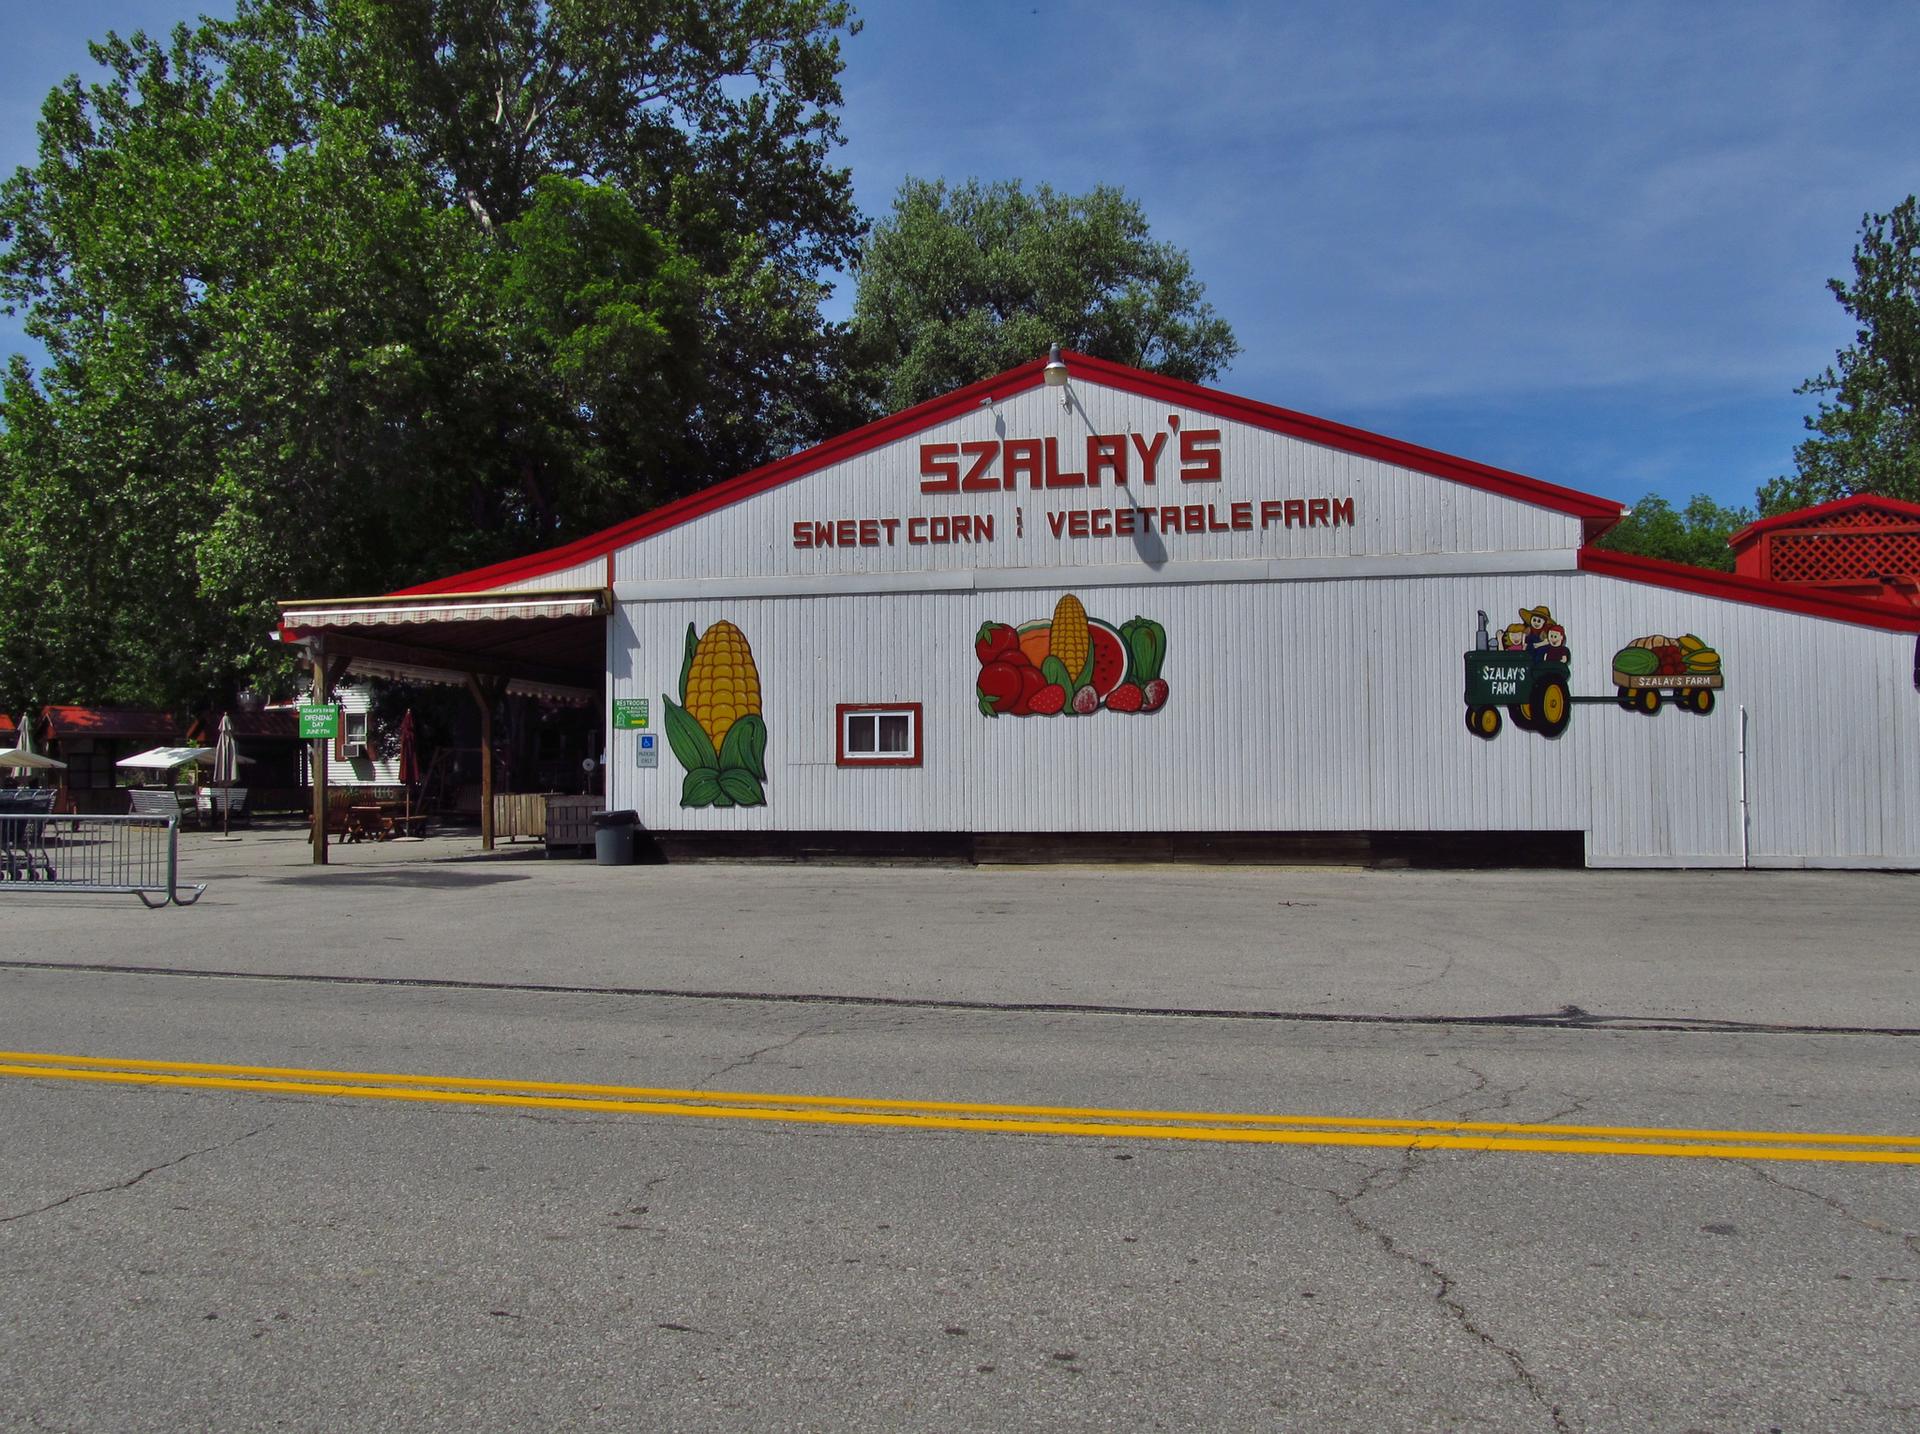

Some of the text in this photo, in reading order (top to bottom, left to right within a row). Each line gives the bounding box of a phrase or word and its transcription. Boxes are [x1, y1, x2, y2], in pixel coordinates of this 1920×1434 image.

[920, 415, 1221, 494] SZALAY'S
[1046, 503, 1253, 539] VEGETABLE
[1260, 497, 1355, 530] FARM
[793, 518, 900, 548] SWEET
[907, 514, 995, 545] CORN
[1482, 665, 1526, 681] SZALAY'S
[1638, 676, 1711, 687] SZALAY'S FARM
[1491, 681, 1516, 695] FARM
